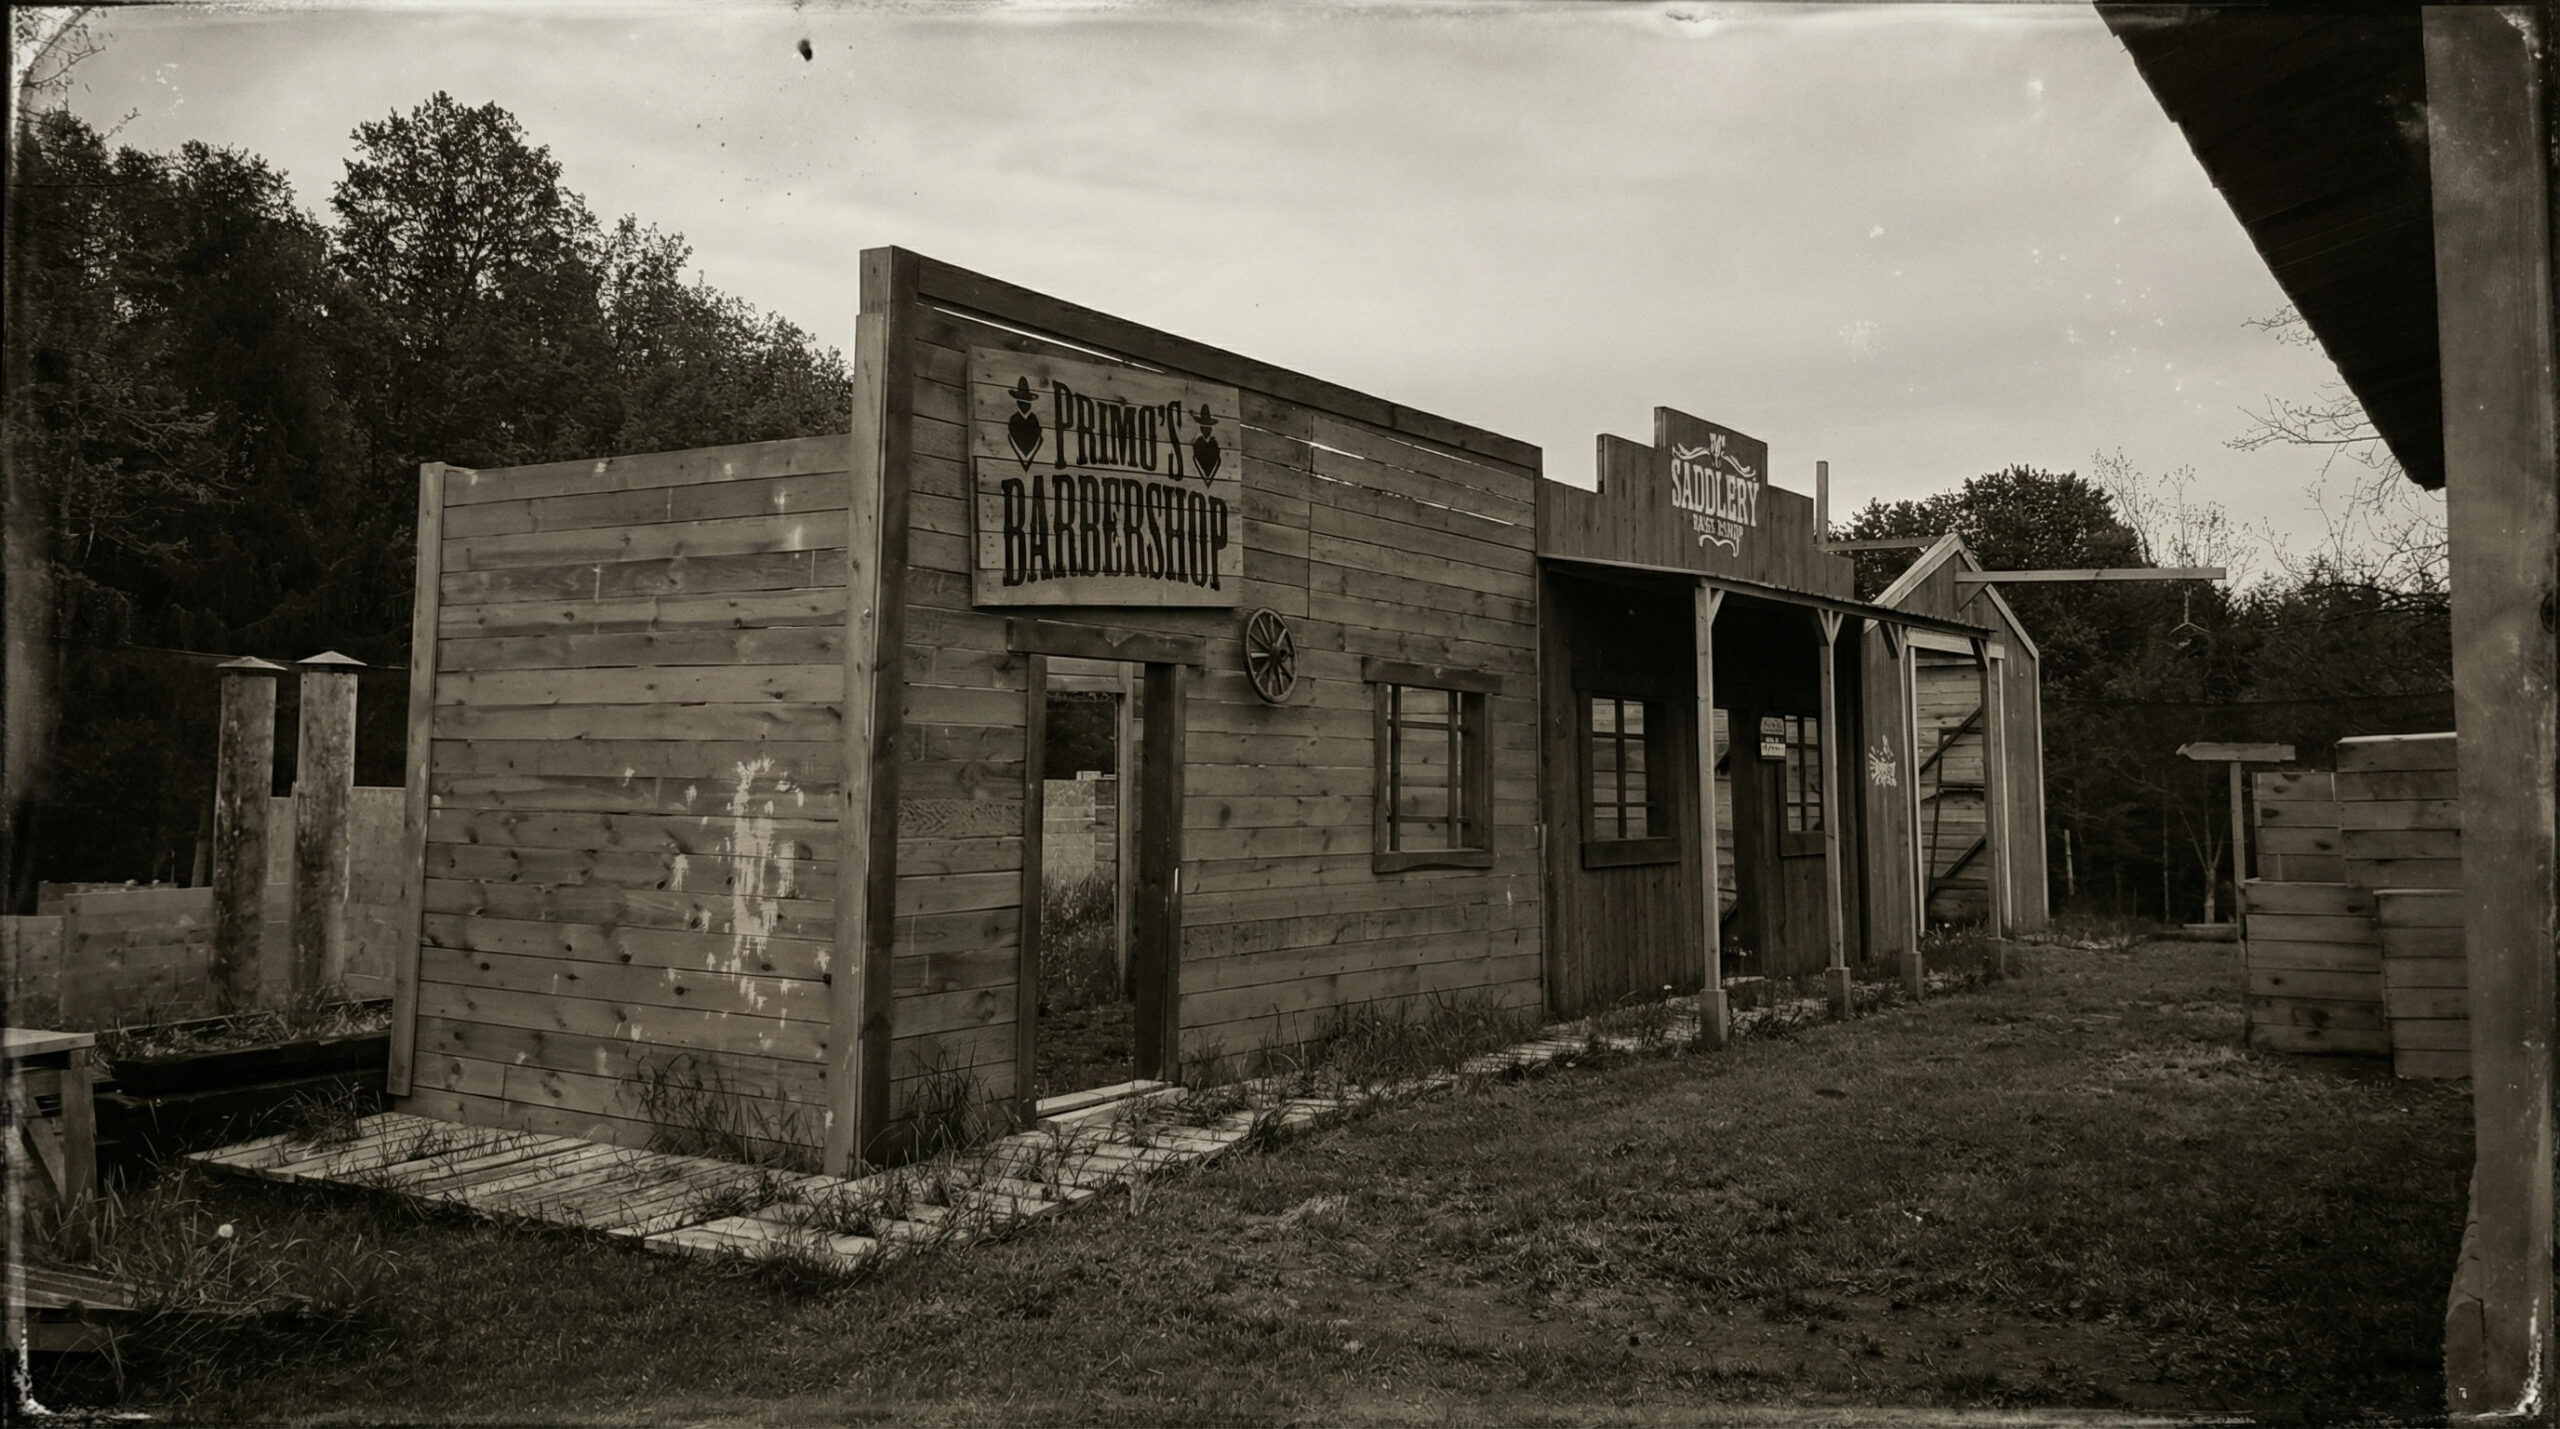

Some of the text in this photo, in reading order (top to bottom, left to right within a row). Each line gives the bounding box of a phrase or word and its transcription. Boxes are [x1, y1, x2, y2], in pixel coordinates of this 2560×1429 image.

[1052, 379, 1185, 481] PRIMO'S
[1001, 474, 1228, 592] BARBERSHOP
[1671, 458, 1760, 528] SADDLERY
